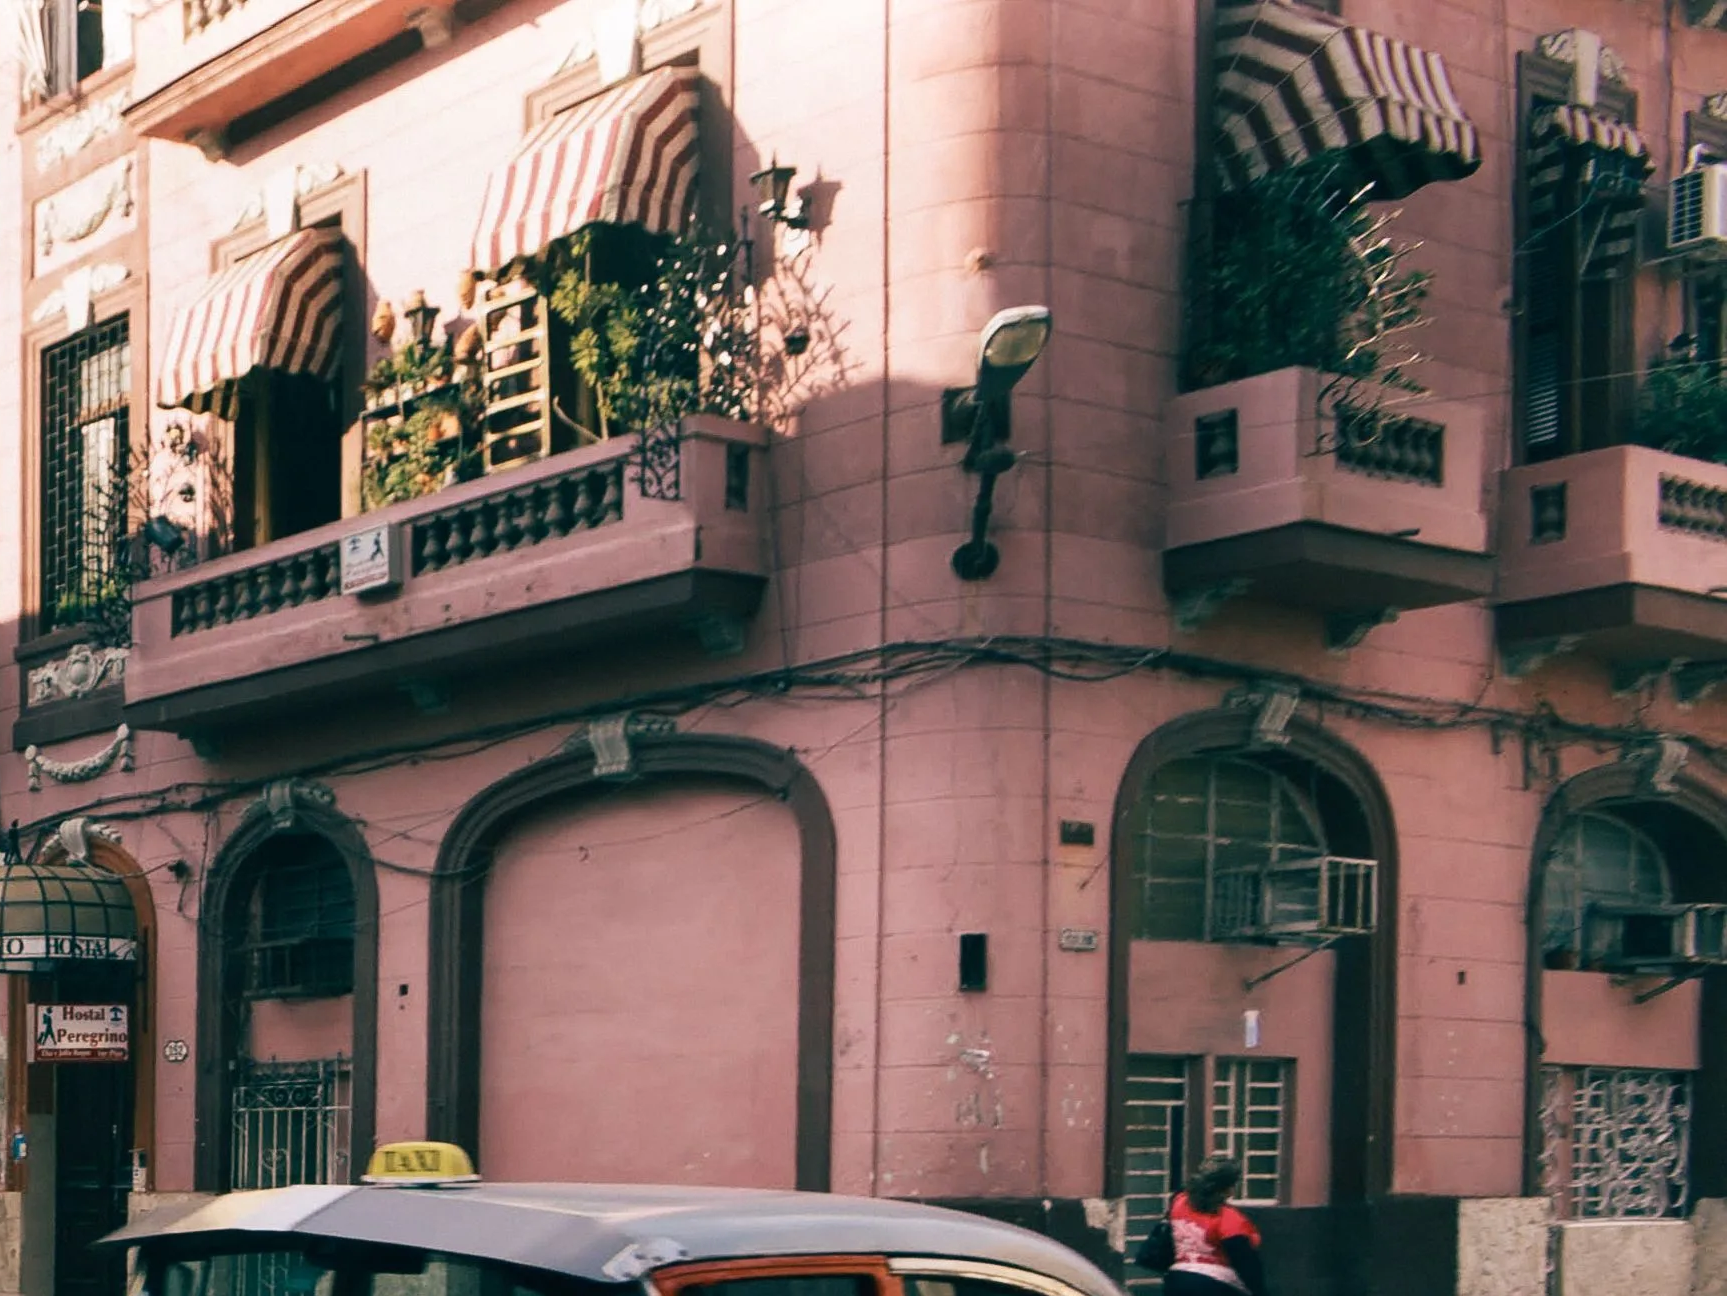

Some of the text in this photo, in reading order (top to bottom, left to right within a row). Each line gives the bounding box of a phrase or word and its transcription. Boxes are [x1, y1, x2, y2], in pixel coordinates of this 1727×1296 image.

[62, 1005, 105, 1021] Hostal
[57, 1027, 128, 1046] Peregrino
[383, 1150, 441, 1172] TAXI
